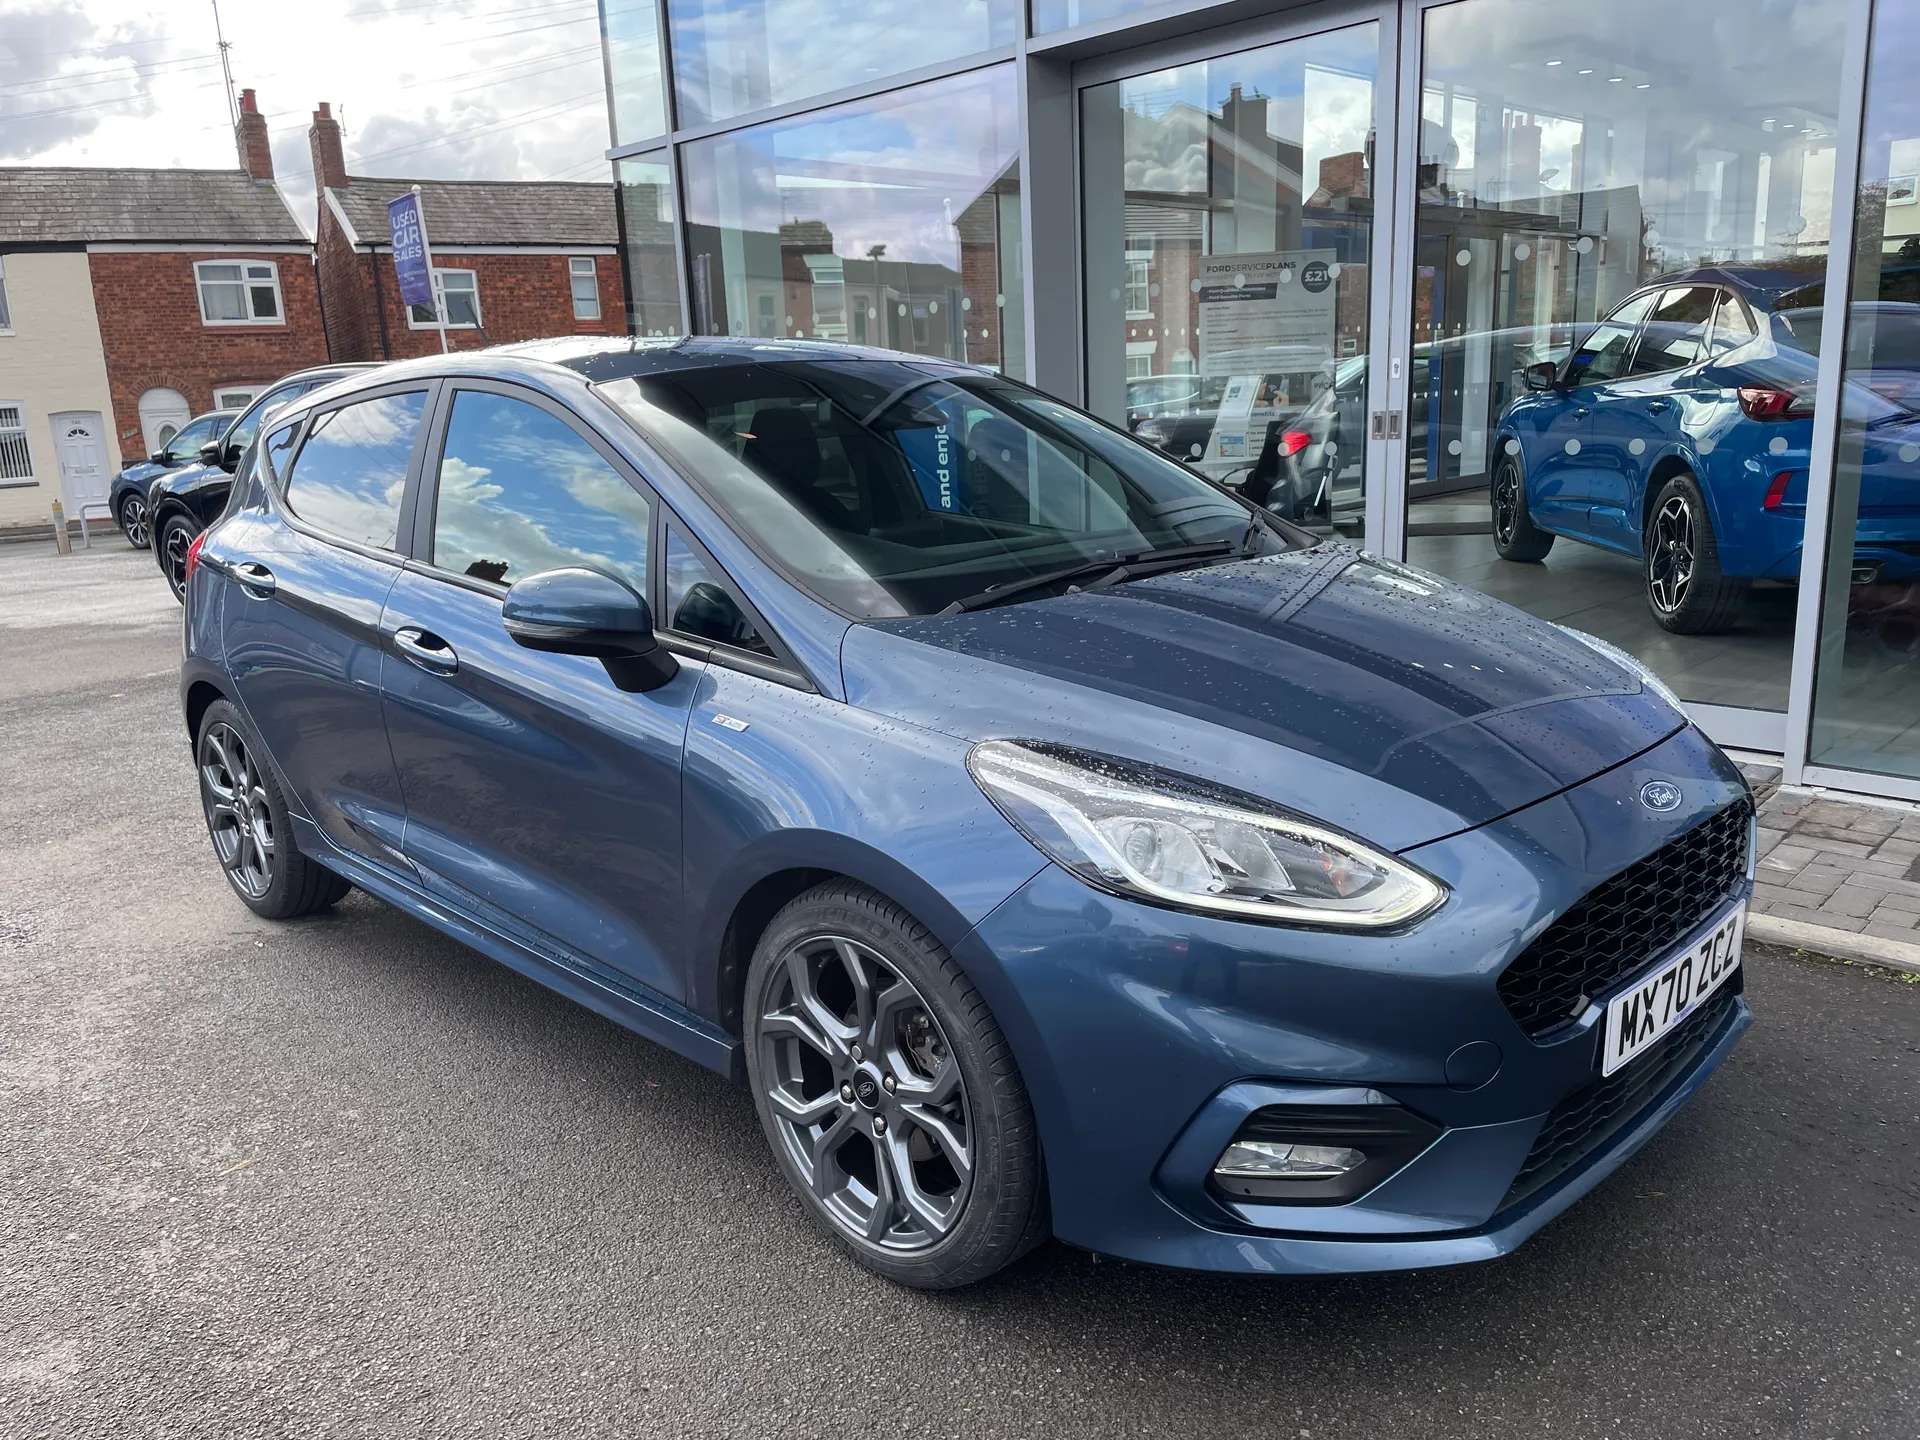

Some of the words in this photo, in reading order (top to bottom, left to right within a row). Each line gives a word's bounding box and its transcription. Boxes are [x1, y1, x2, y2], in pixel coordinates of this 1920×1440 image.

[392, 210, 417, 230] USED
[393, 225, 421, 249] CAR
[393, 245, 422, 263] SALES
[1304, 269, 1329, 282] £21
[934, 425, 951, 466] enjo
[936, 469, 952, 509] and
[1648, 787, 1674, 806] Ford
[1618, 956, 1693, 1057] MX70
[1696, 916, 1738, 998] ZCZ
